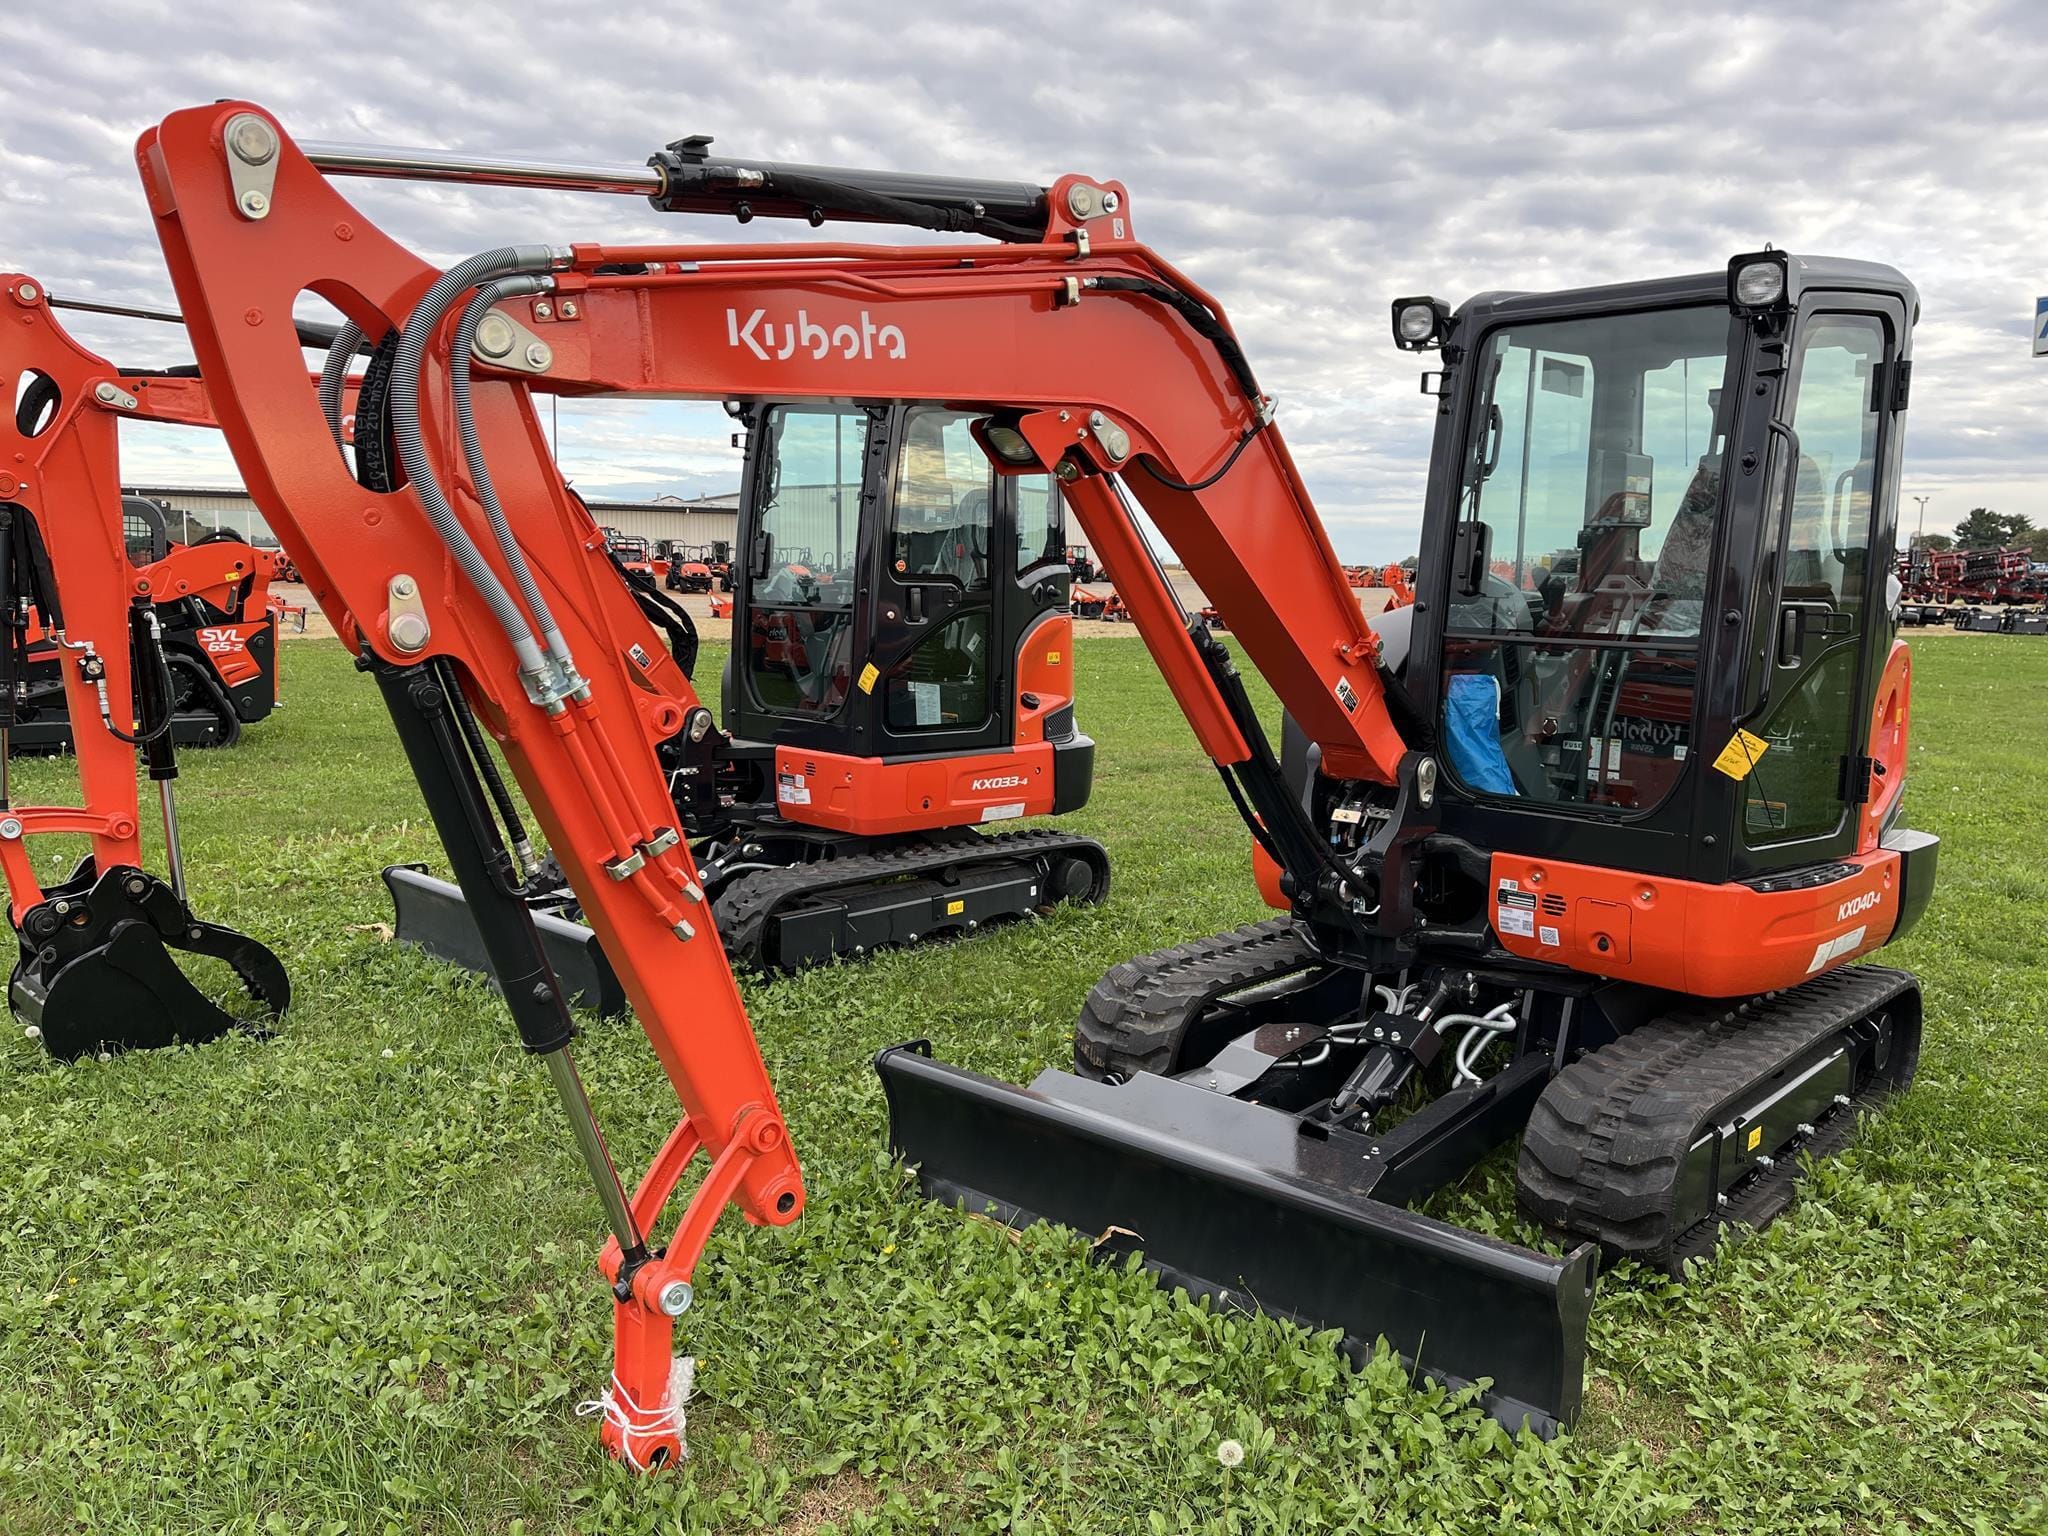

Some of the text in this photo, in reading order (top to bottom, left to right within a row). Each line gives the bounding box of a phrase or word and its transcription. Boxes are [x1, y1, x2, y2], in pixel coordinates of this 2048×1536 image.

[726, 308, 907, 361] Kubota
[200, 629, 245, 642] SVL
[207, 641, 243, 652] 65-2
[971, 776, 1028, 791] KX033-4
[1837, 891, 1881, 922] KX040-4
